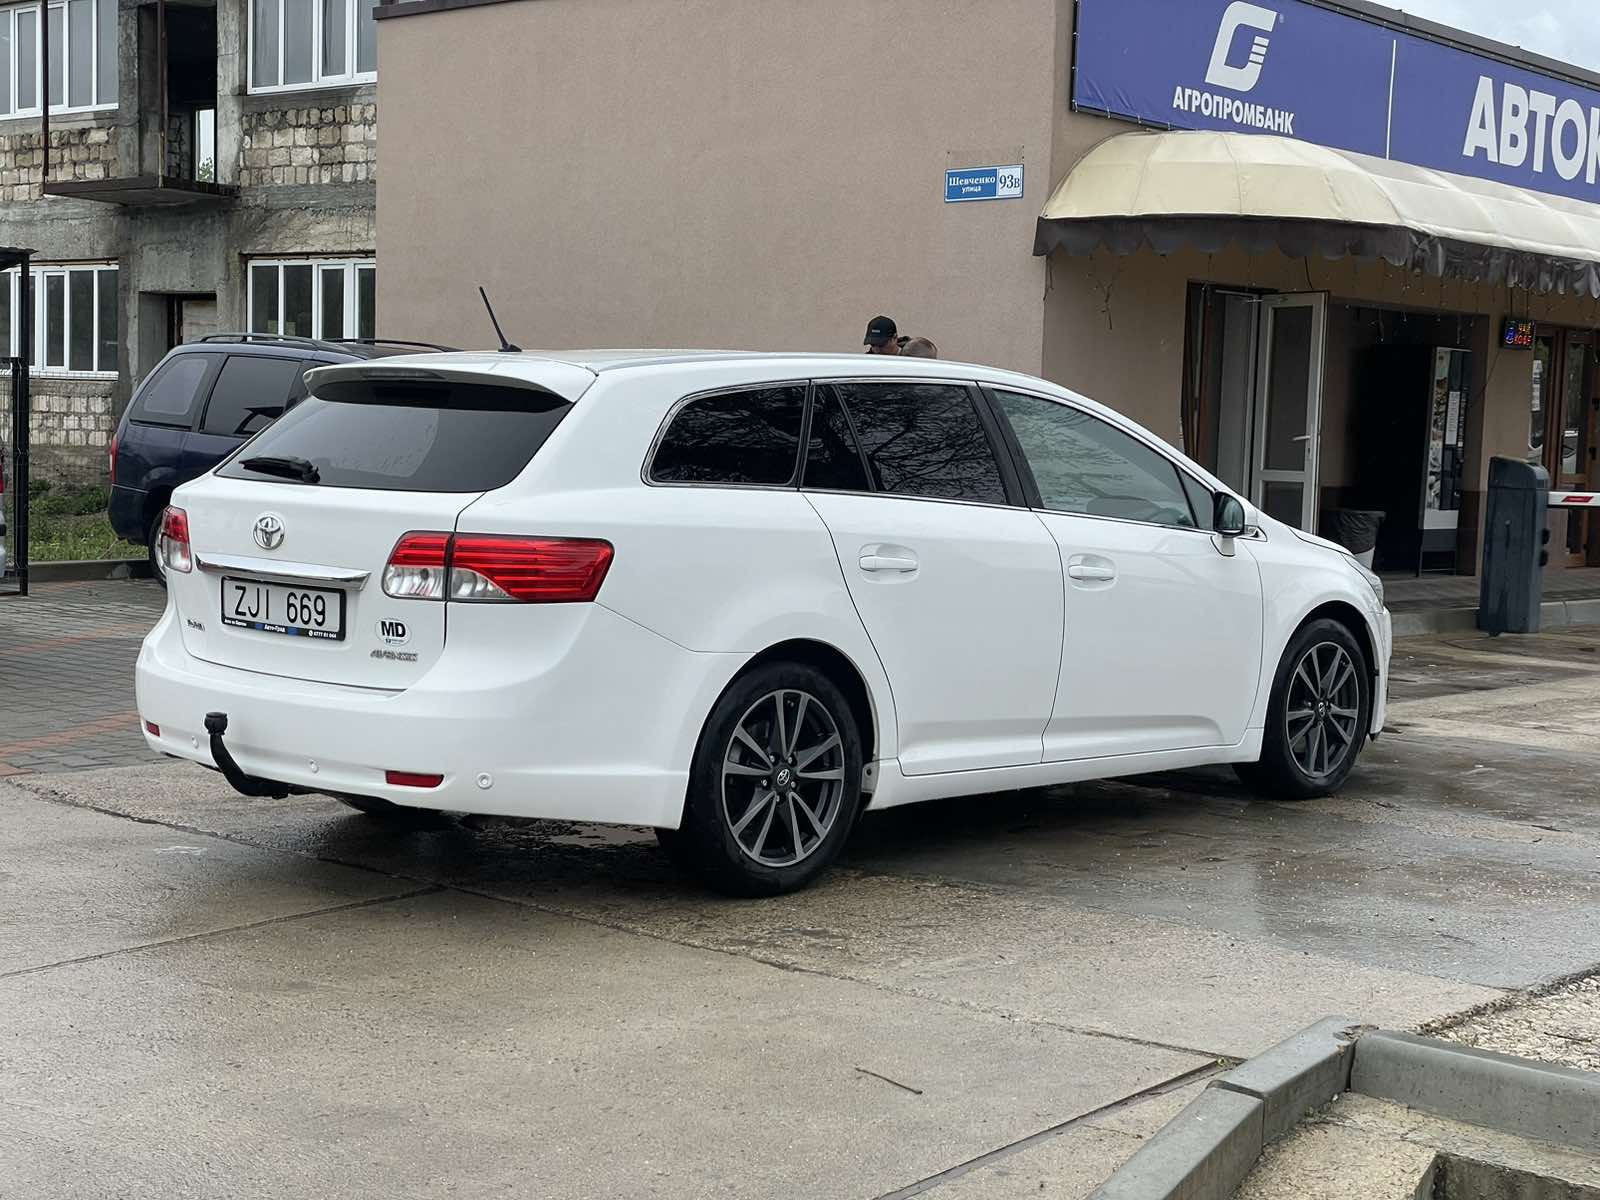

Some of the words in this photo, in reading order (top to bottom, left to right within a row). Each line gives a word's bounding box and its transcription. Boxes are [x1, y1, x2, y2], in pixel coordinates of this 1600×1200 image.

[1172, 86, 1294, 135] АГРОПРОМБАНК
[949, 176, 996, 186] Шевченко
[961, 185, 982, 194] улица
[234, 585, 269, 619] ZJI
[287, 592, 326, 626] 669
[381, 620, 406, 638] MD
